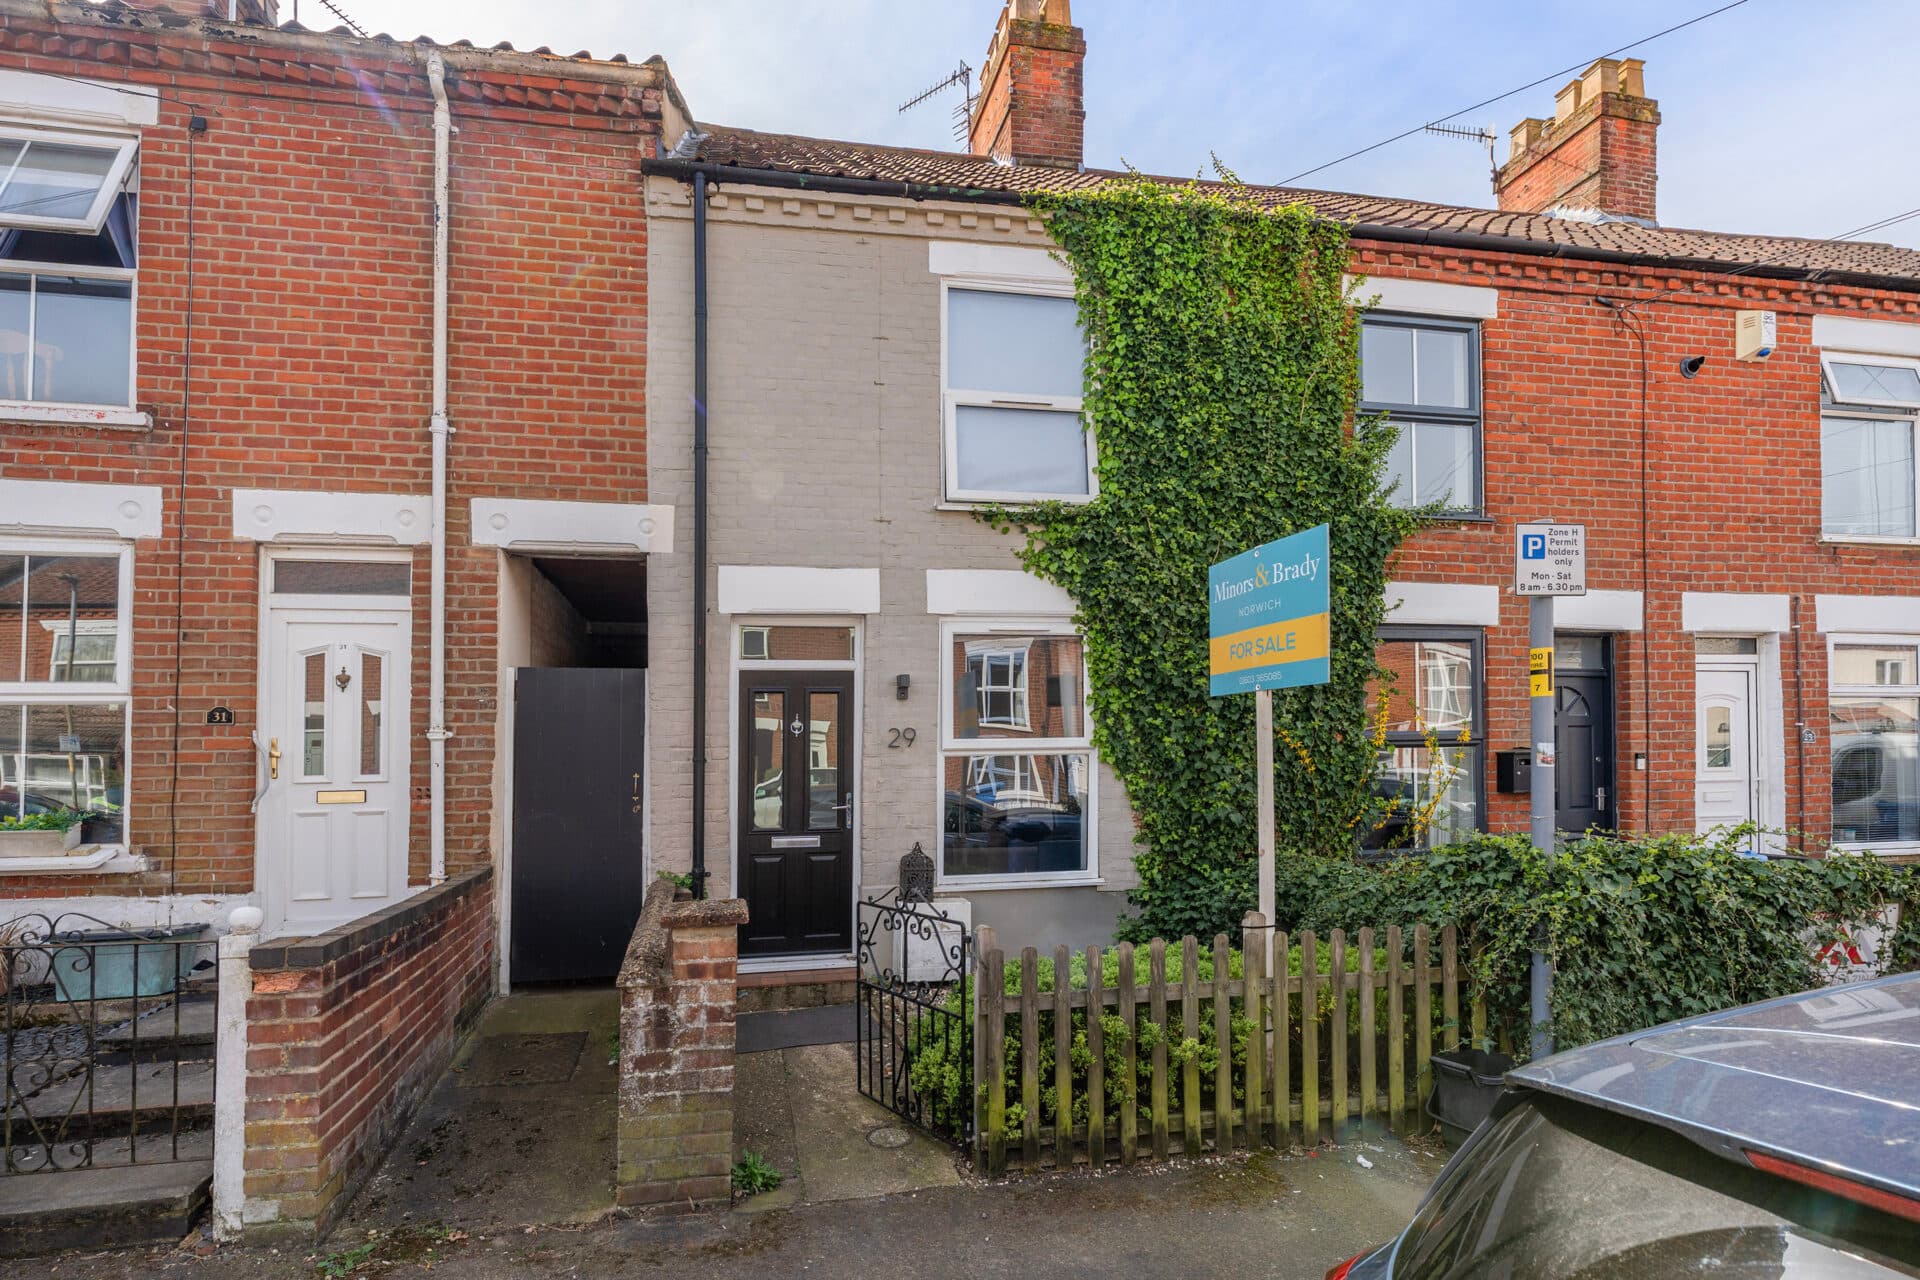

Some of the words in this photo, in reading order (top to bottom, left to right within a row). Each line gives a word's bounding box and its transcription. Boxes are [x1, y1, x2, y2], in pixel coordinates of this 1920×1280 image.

[1548, 528, 1569, 536] Zone
[1572, 528, 1578, 536] H
[1549, 538, 1578, 546] Permit
[1547, 548, 1580, 556] holders
[1554, 558, 1573, 566] only
[1214, 577, 1254, 603] Minors
[1255, 563, 1271, 588] &
[1272, 552, 1321, 585] Brady
[1531, 572, 1550, 580] Mon
[1556, 572, 1572, 580] Sat
[1520, 583, 1526, 591] 8
[1547, 583, 1568, 591] 6.30
[1238, 597, 1281, 617] NORWICH
[1230, 641, 1254, 661] FOR
[1255, 632, 1297, 656] SALE
[1534, 684, 1541, 692] 7
[212, 711, 227, 722] 31
[888, 727, 917, 748] 29
